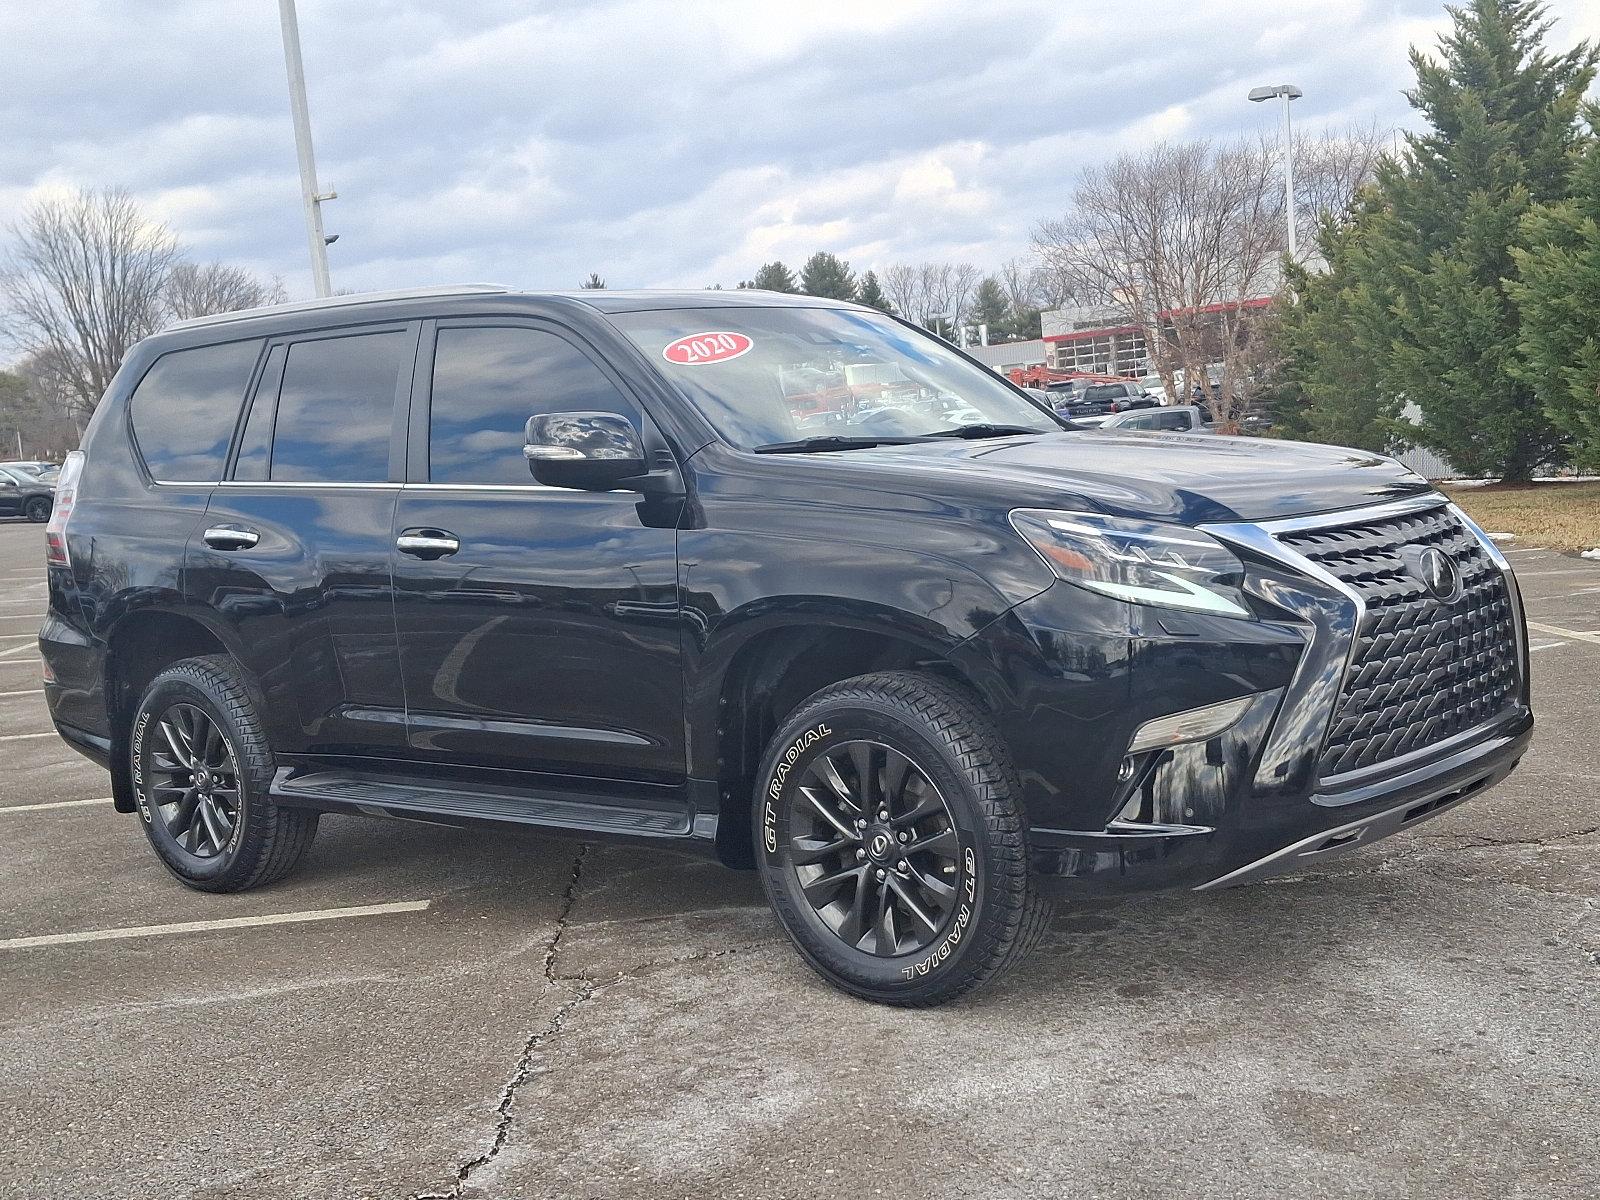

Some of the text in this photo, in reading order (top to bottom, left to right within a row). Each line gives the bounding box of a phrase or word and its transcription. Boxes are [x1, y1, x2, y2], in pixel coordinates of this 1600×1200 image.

[678, 334, 737, 362] 2020
[134, 712, 152, 823] GT RADIAL
[765, 723, 832, 853] GT RADIAL
[901, 847, 976, 980] GT RADIAL
